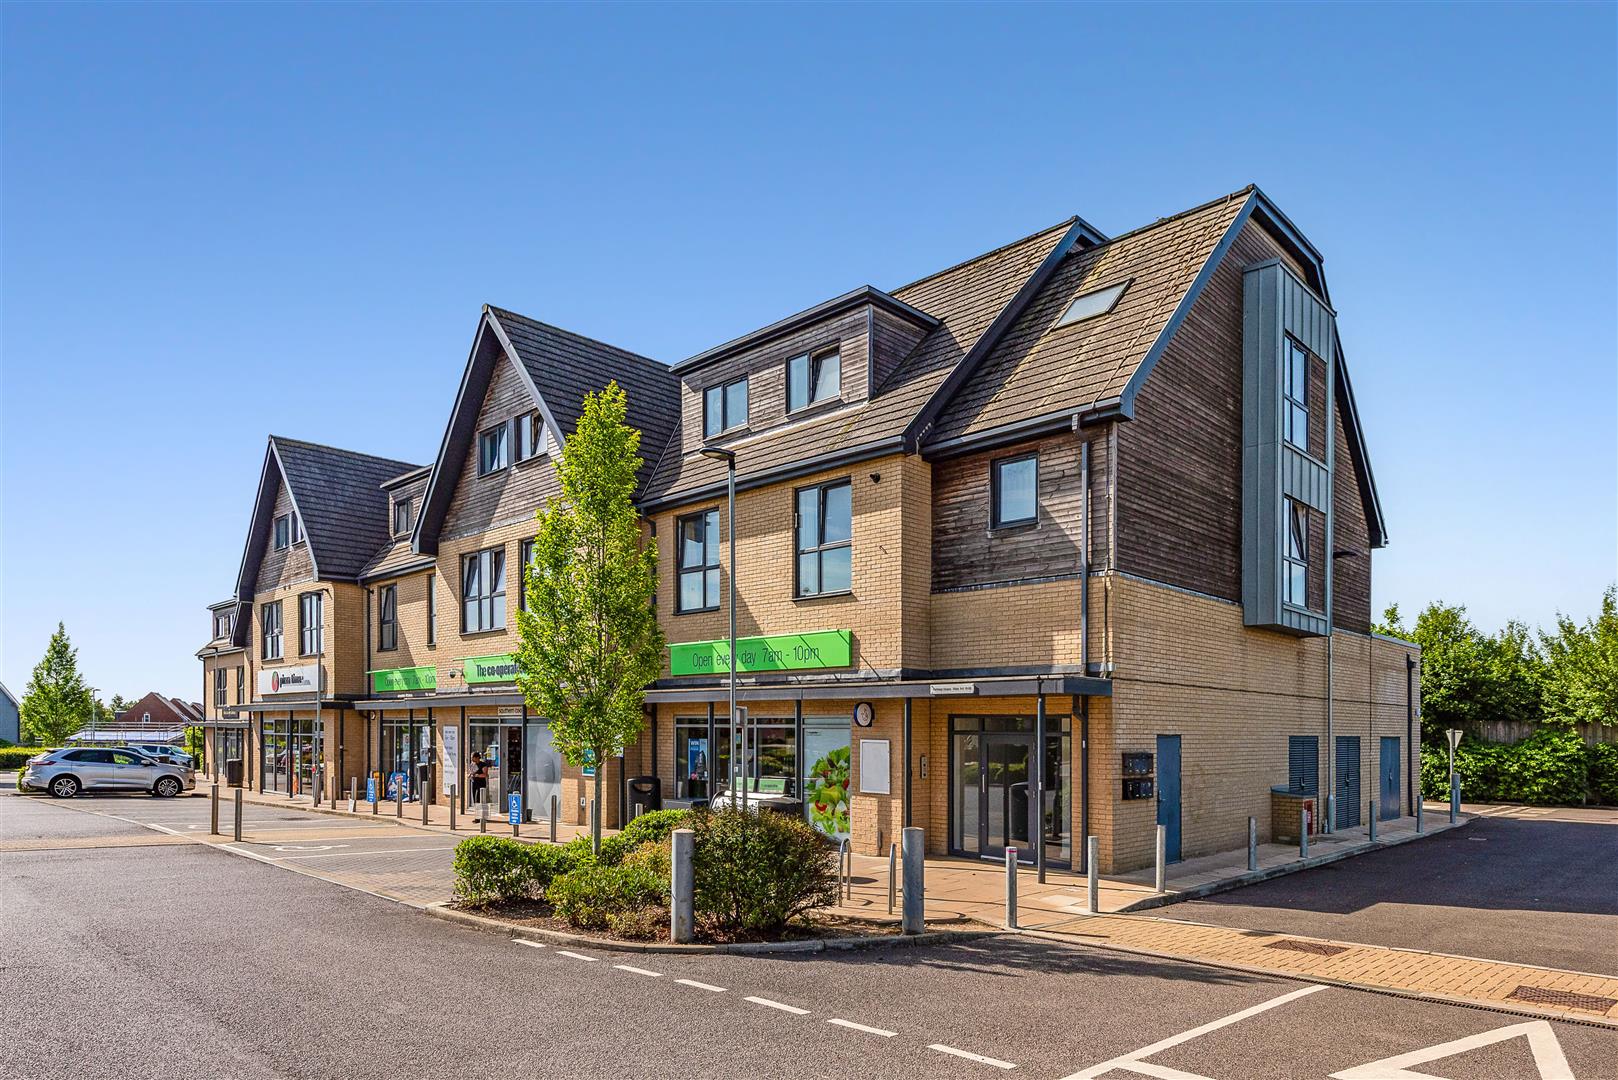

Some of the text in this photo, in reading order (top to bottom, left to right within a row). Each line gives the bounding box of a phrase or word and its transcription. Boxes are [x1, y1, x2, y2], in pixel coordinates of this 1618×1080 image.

[692, 653, 713, 670] Open
[716, 654, 739, 668] eve
[741, 650, 757, 666] day
[762, 648, 783, 663] 7am
[793, 646, 820, 663] 10pm
[476, 664, 487, 678] The
